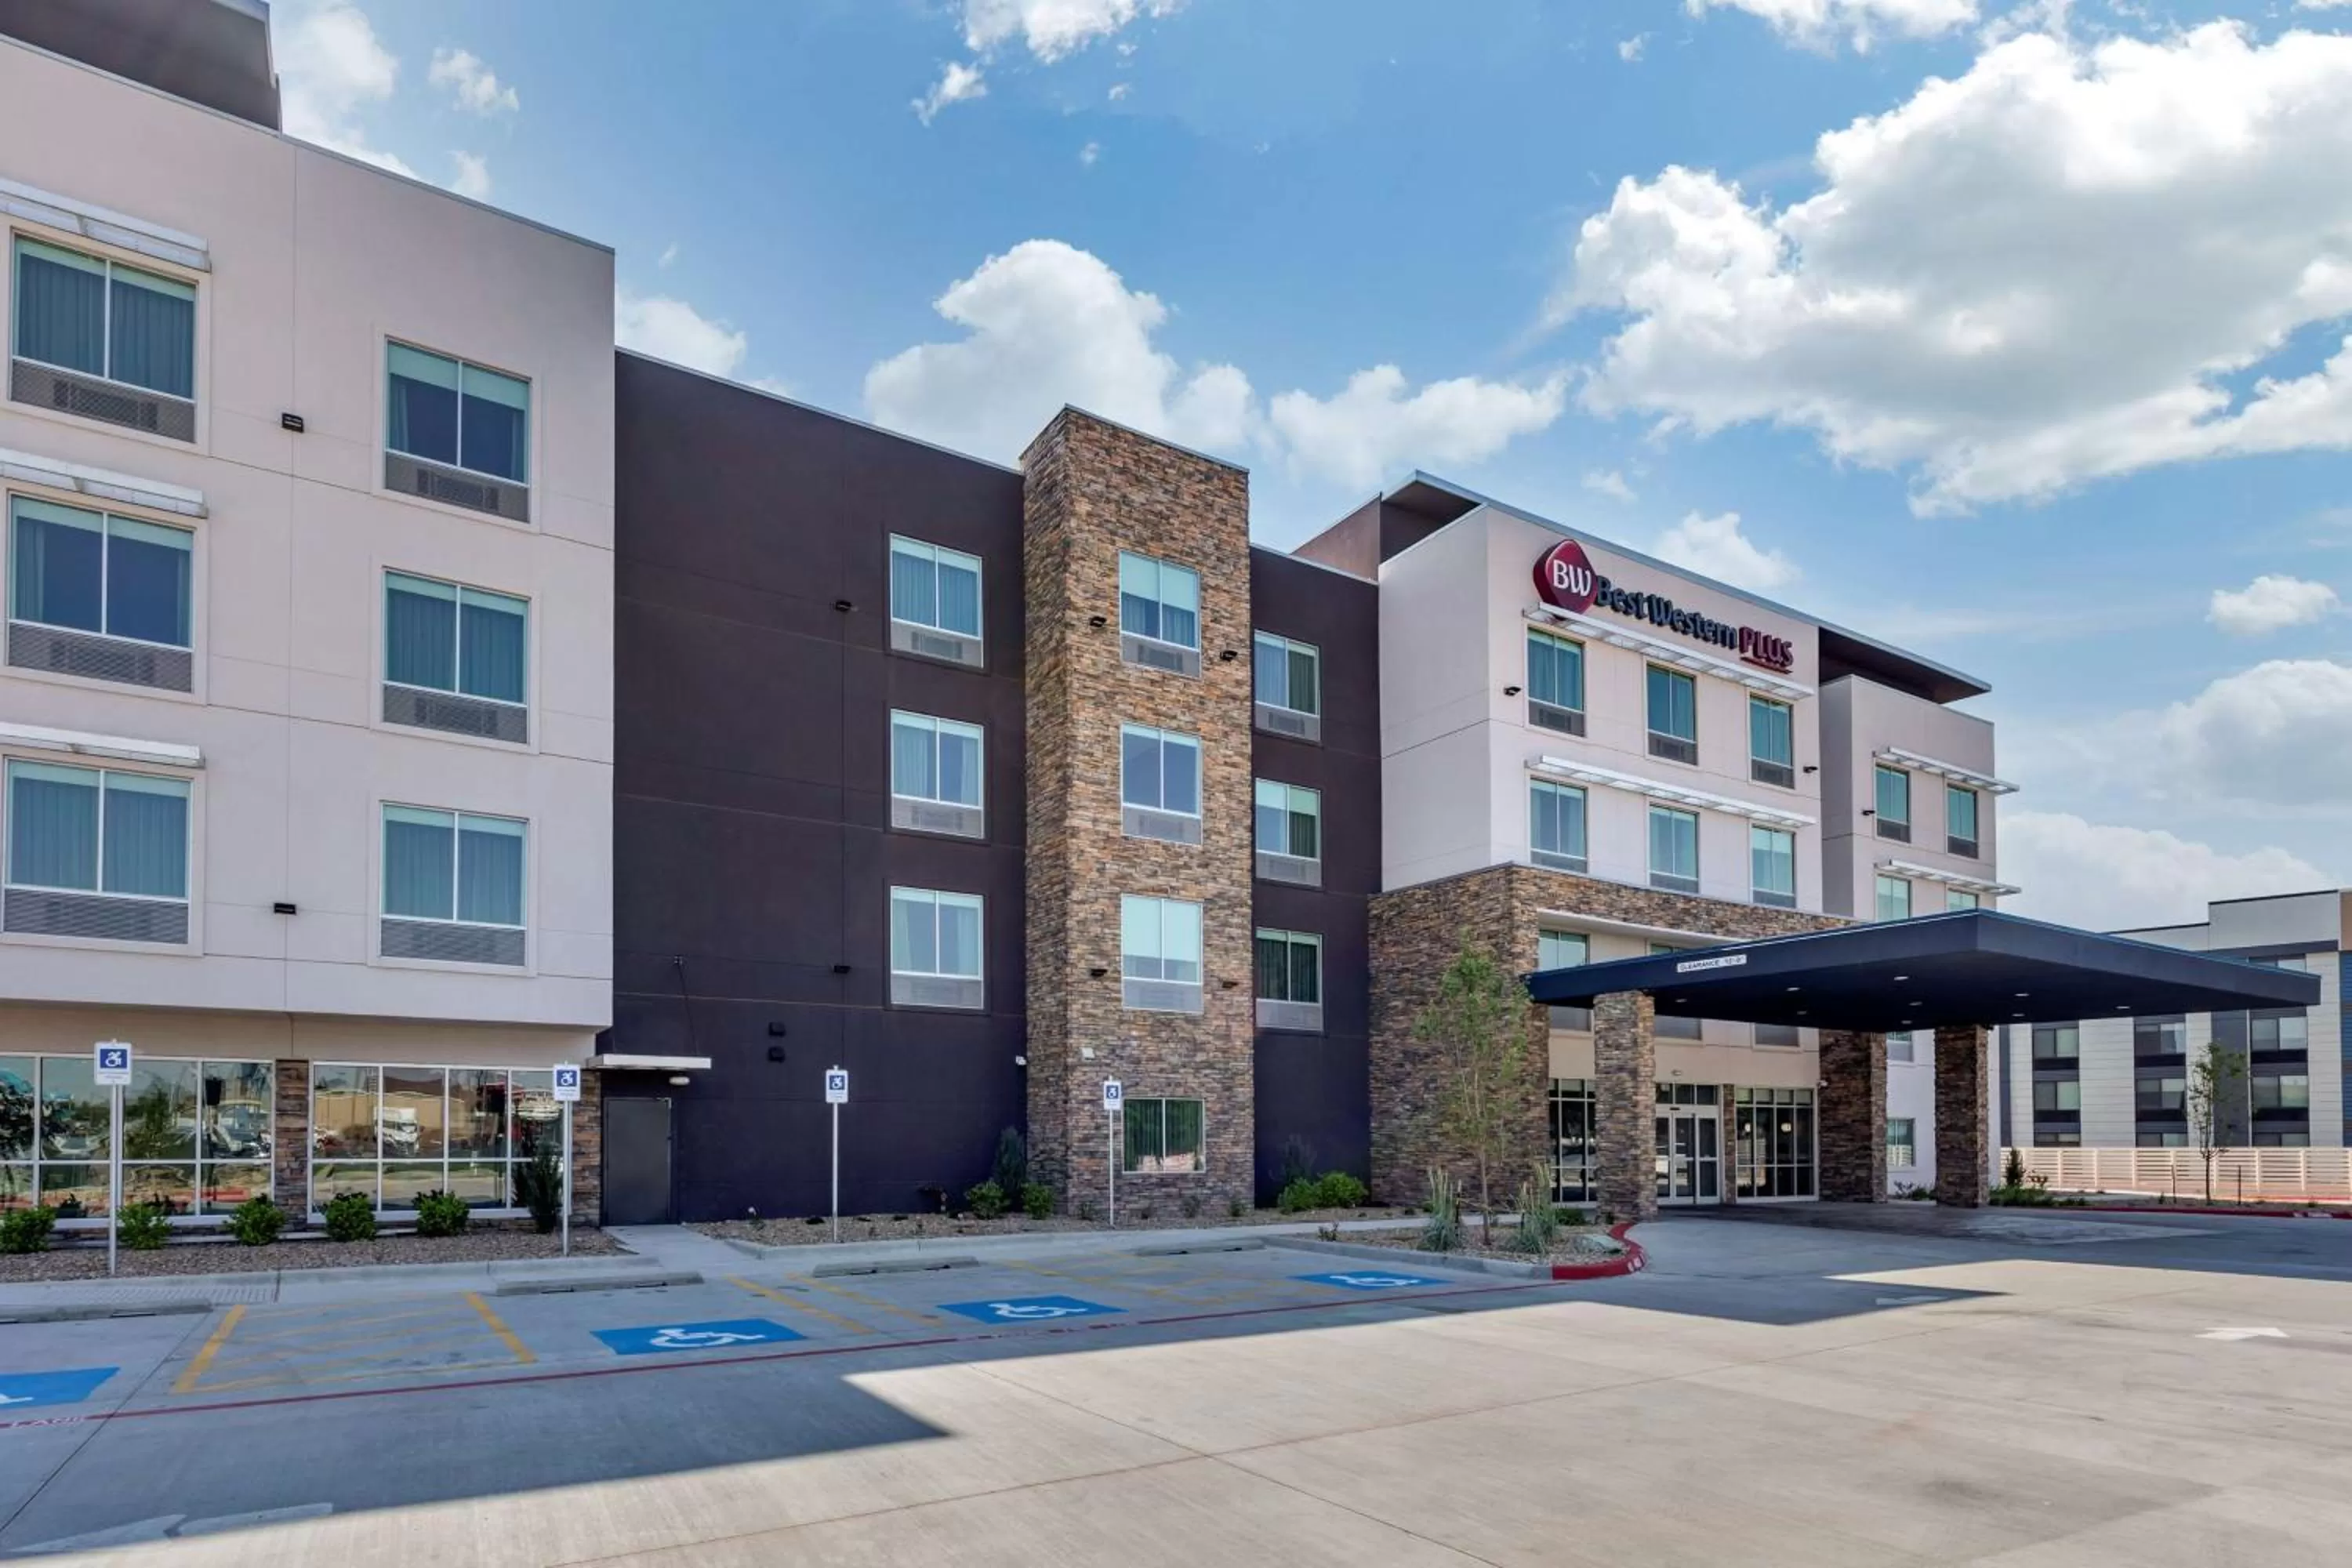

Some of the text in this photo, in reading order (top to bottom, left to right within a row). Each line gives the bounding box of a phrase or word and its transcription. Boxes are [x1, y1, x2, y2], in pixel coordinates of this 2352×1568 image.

[1552, 559, 1592, 597] BW
[1595, 575, 1794, 668] Best Western PLUS
